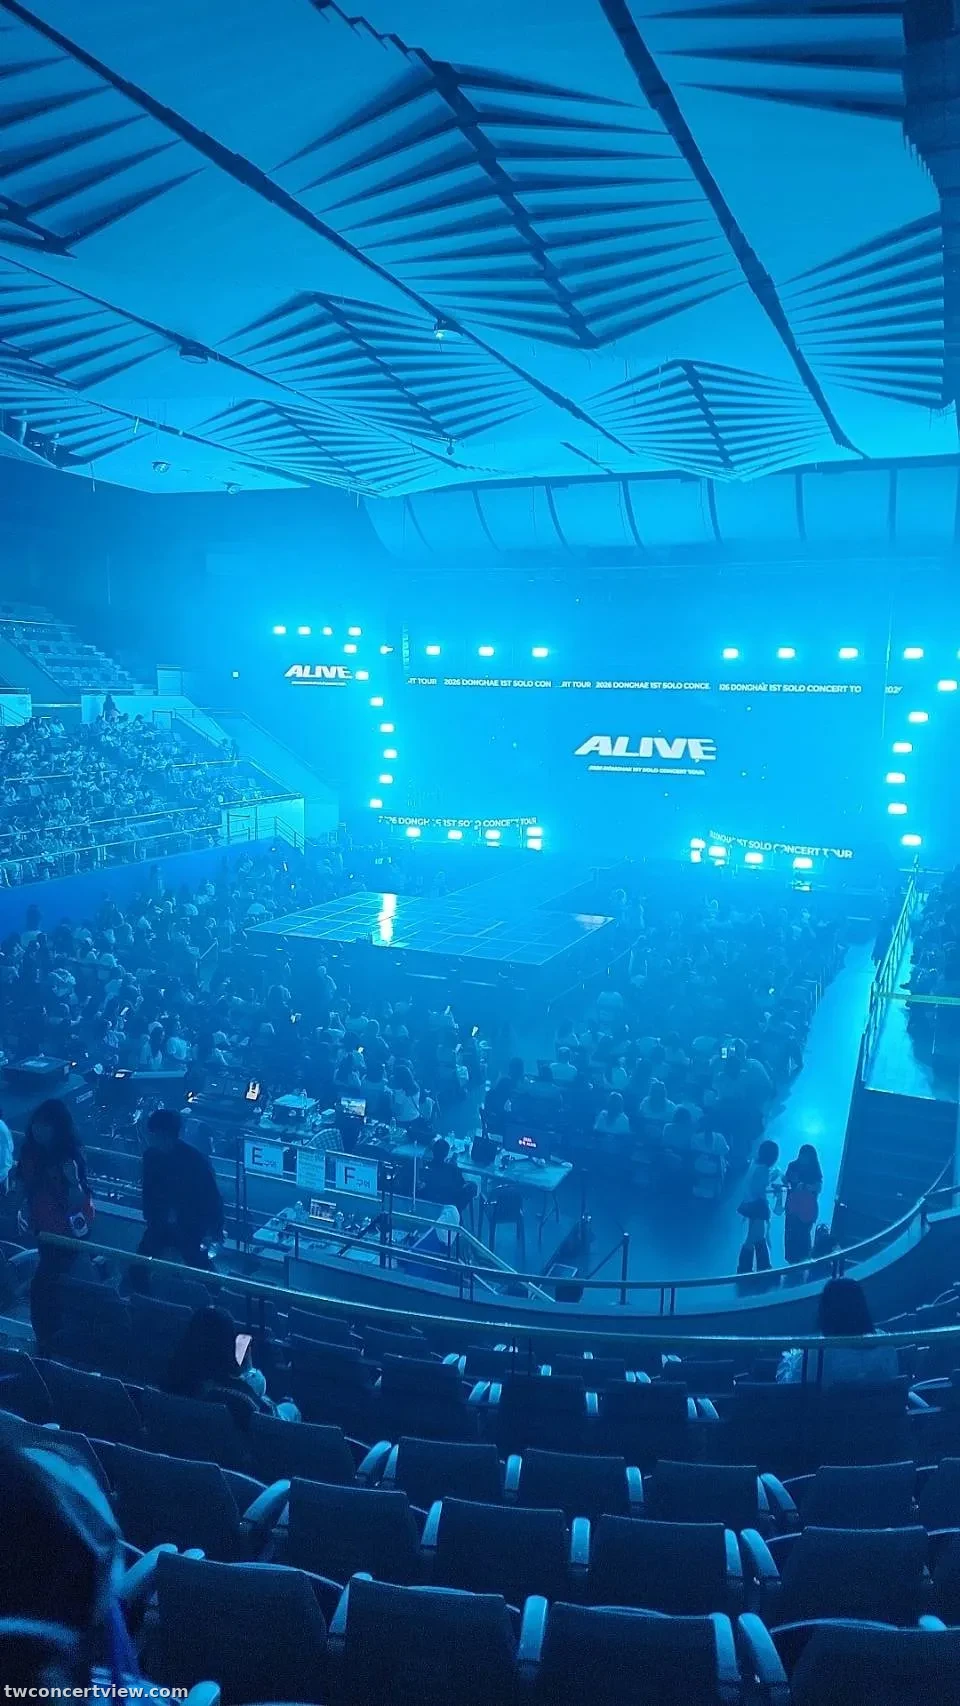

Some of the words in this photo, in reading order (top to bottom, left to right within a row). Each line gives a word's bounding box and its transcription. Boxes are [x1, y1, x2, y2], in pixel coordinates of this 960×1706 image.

[284, 664, 353, 679] ALIVE
[443, 678, 461, 686] 2026
[613, 681, 650, 689] DONGHAE
[730, 683, 769, 692] DONGHAE
[769, 684, 782, 692] 1ST
[783, 684, 806, 693] SOLO
[806, 685, 848, 693] CONCERT
[574, 735, 717, 760] ALIVE
[748, 840, 772, 850] SOLO
[252, 1146, 264, 1166] E
[344, 1166, 356, 1185] F
